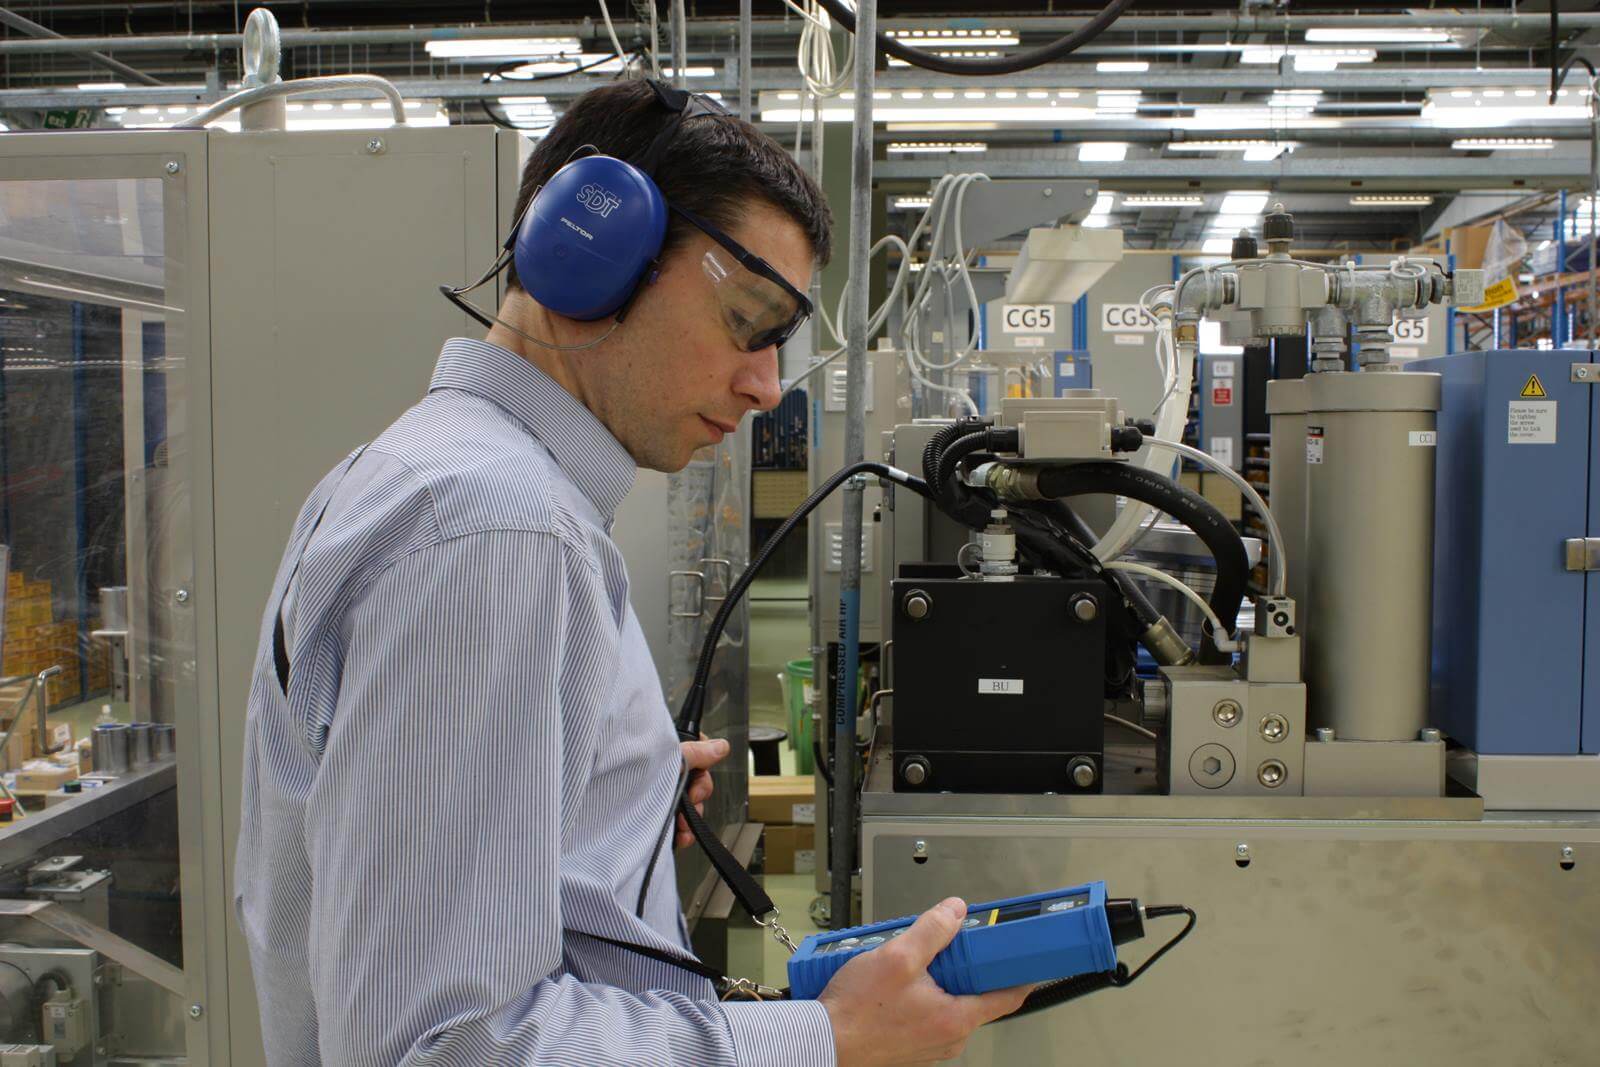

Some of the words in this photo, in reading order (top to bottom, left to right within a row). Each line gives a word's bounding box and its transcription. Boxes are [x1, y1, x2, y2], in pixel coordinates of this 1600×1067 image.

[576, 183, 620, 218] SDT
[560, 217, 594, 241] PELTOR
[1006, 308, 1051, 328] CG5
[1106, 307, 1150, 327] CG5
[1394, 319, 1425, 338] G5
[838, 619, 848, 641] AIR
[837, 643, 848, 726] COMPRESSED
